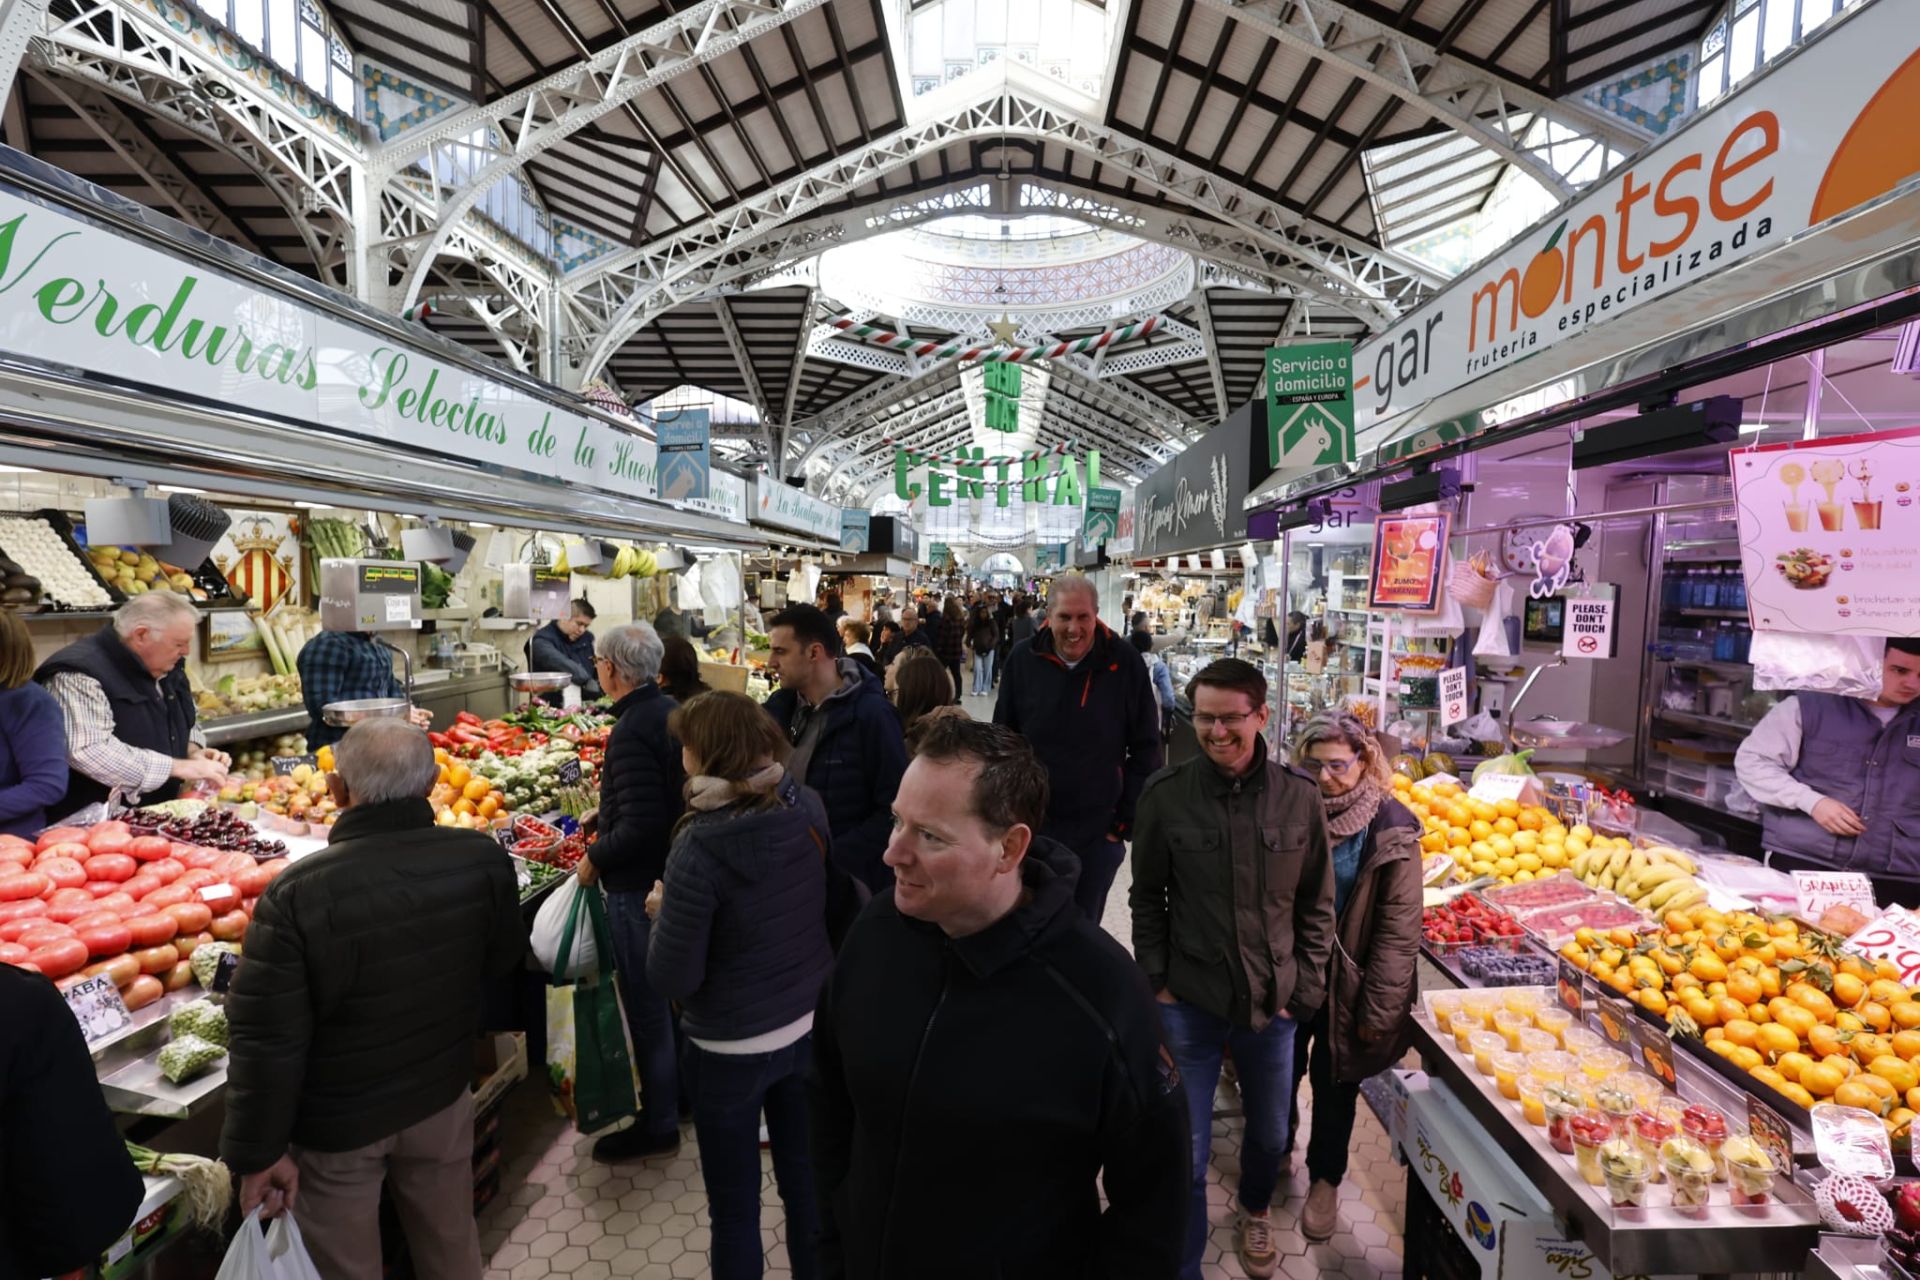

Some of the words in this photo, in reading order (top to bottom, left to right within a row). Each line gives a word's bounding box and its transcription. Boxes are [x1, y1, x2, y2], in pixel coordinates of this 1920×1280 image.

[1466, 330, 1538, 374] frutería
[1558, 217, 1772, 332] especializada
[1272, 354, 1334, 374] Servicio
[1338, 357, 1347, 369] a
[1274, 372, 1346, 392] domicilio
[527, 411, 557, 458] de
[574, 426, 596, 469] la
[1573, 623, 1606, 634] TOUCH
[1445, 691, 1464, 703] TOUCH
[63, 978, 108, 1000] ABA
